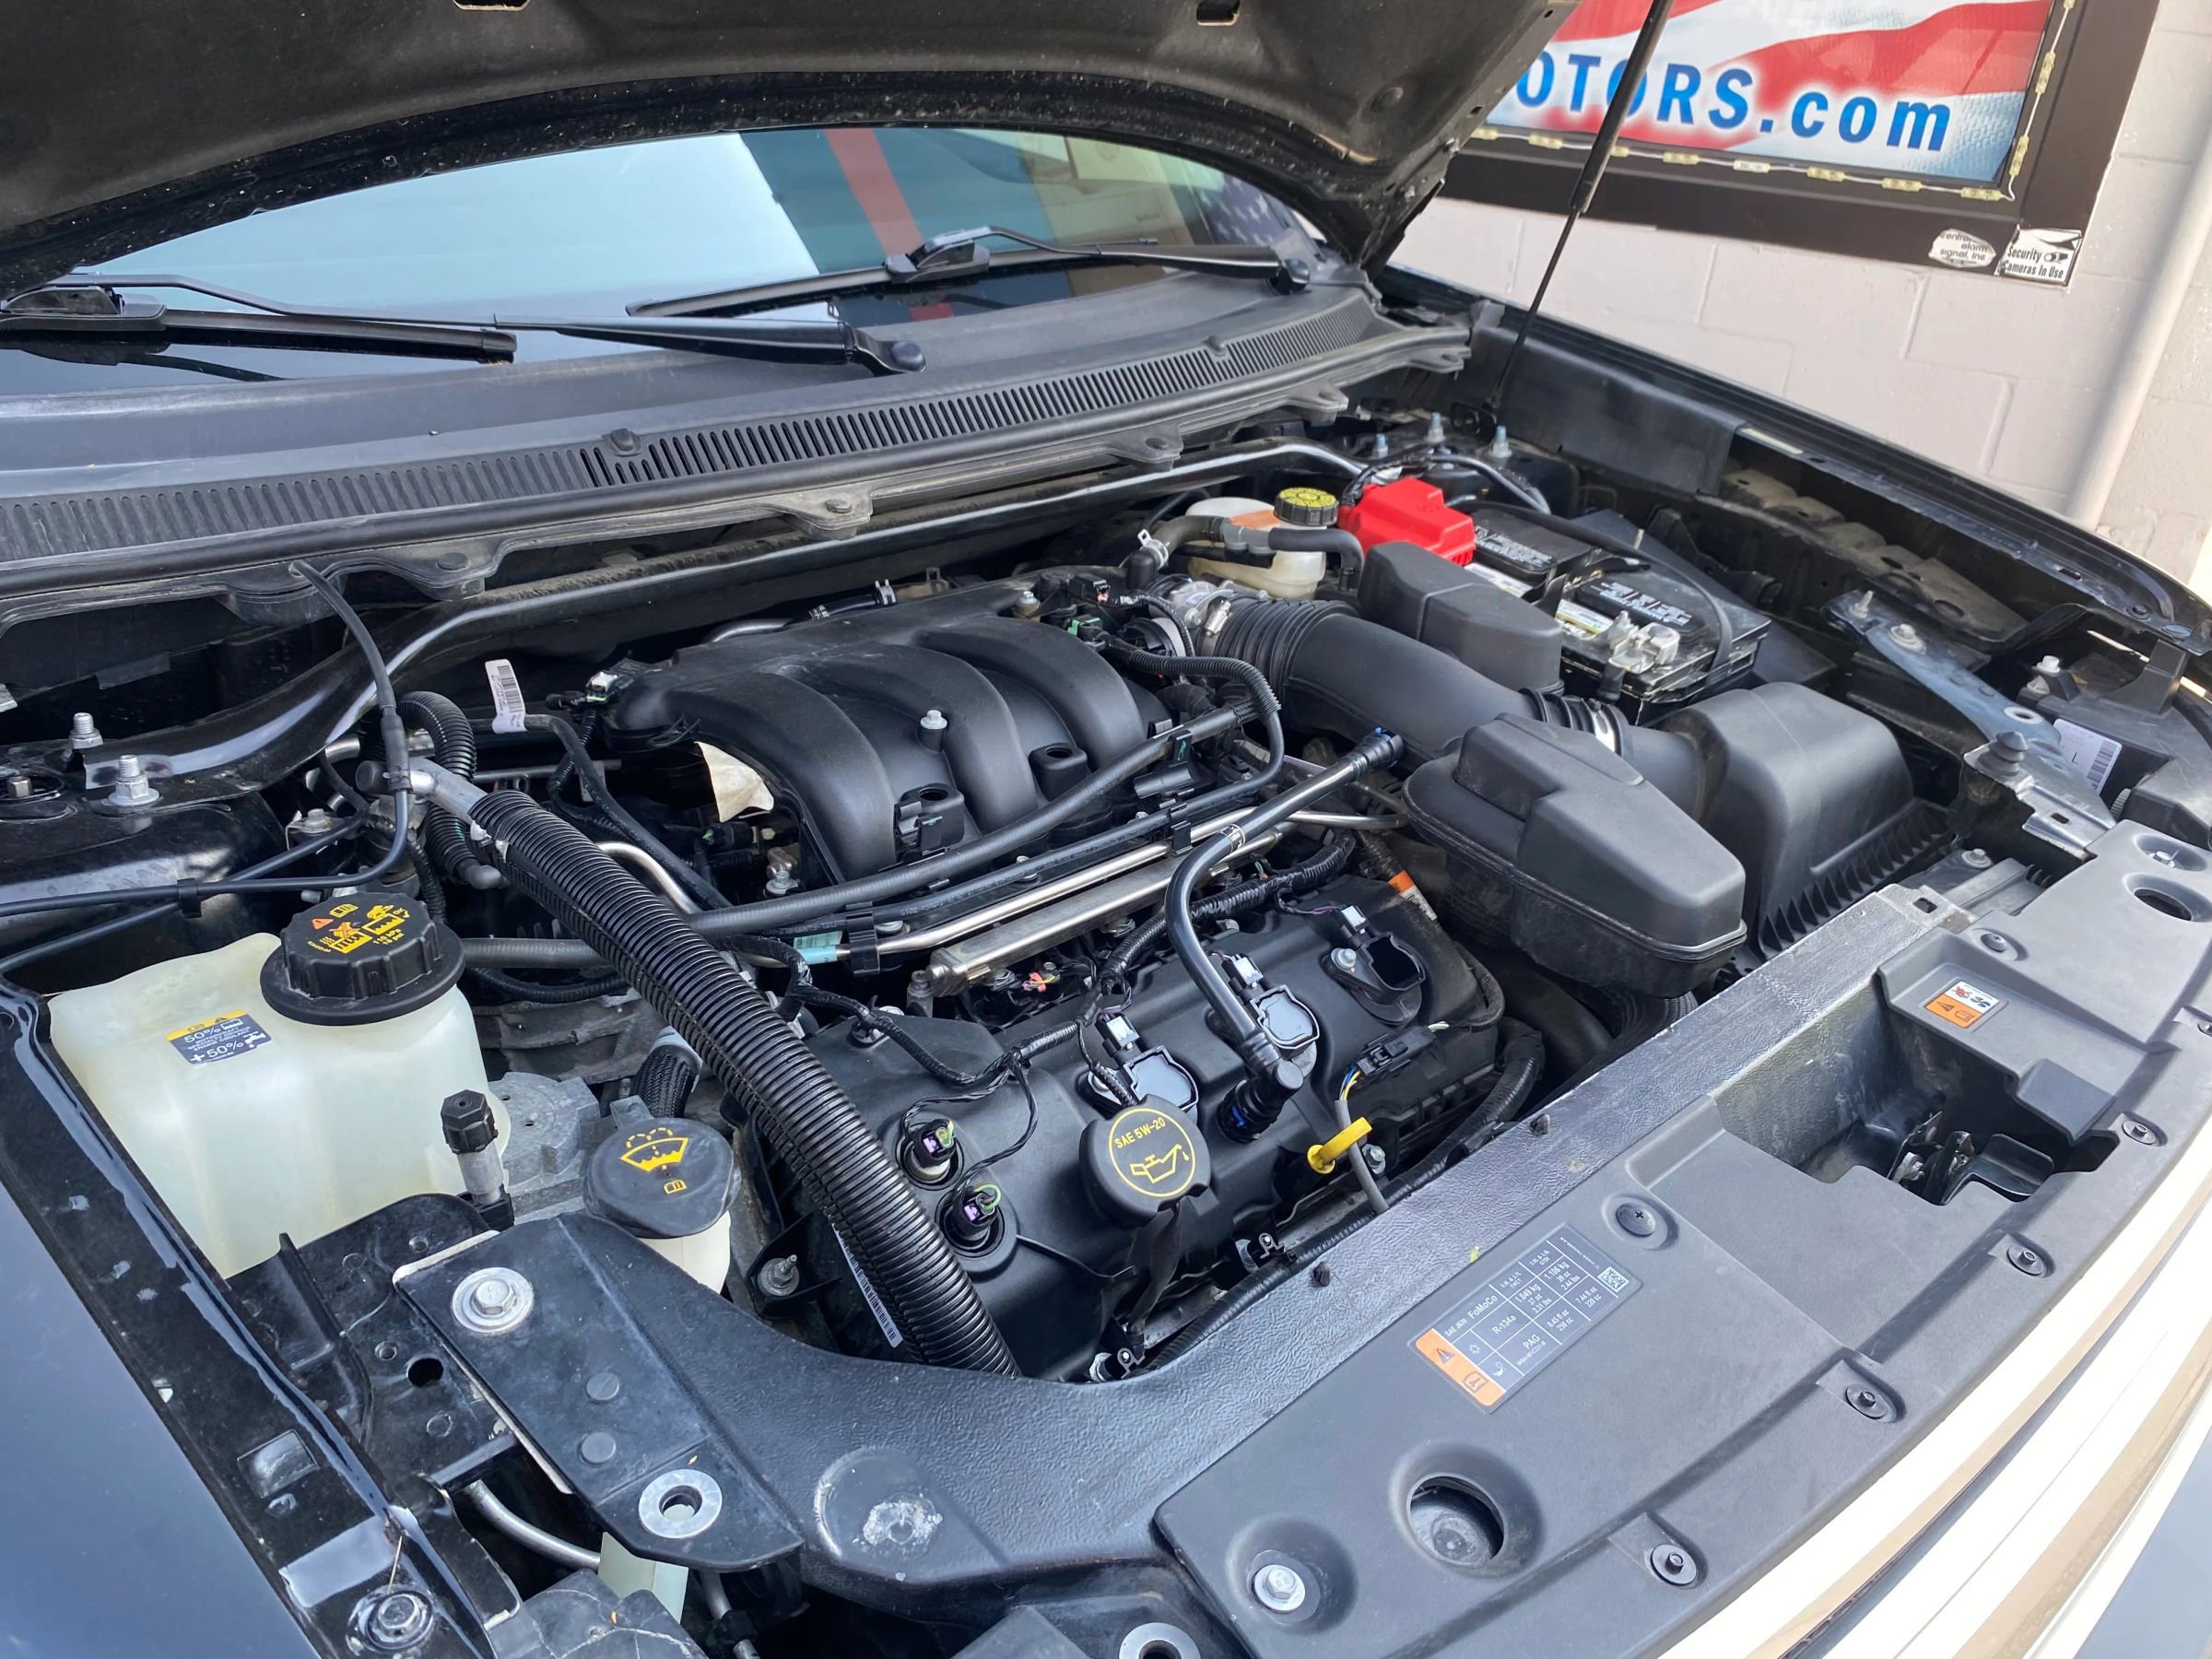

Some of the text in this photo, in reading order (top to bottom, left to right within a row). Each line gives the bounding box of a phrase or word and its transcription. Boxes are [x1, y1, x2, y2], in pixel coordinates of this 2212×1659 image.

[2007, 247, 2042, 264] Security
[2003, 259, 2065, 279] Cameras In Use
[183, 1025, 221, 1043] 50%
[206, 1038, 243, 1058] 50%
[1114, 1117, 1166, 1148] SAE 5W-20
[1557, 1260, 1570, 1270] kg
[1528, 1282, 1542, 1293] kg
[1466, 1293, 1499, 1319] FoMoCo
[1532, 1302, 1545, 1313] 2.31
[1491, 1313, 1517, 1334] R-134a
[1522, 1333, 1541, 1348] PAG
